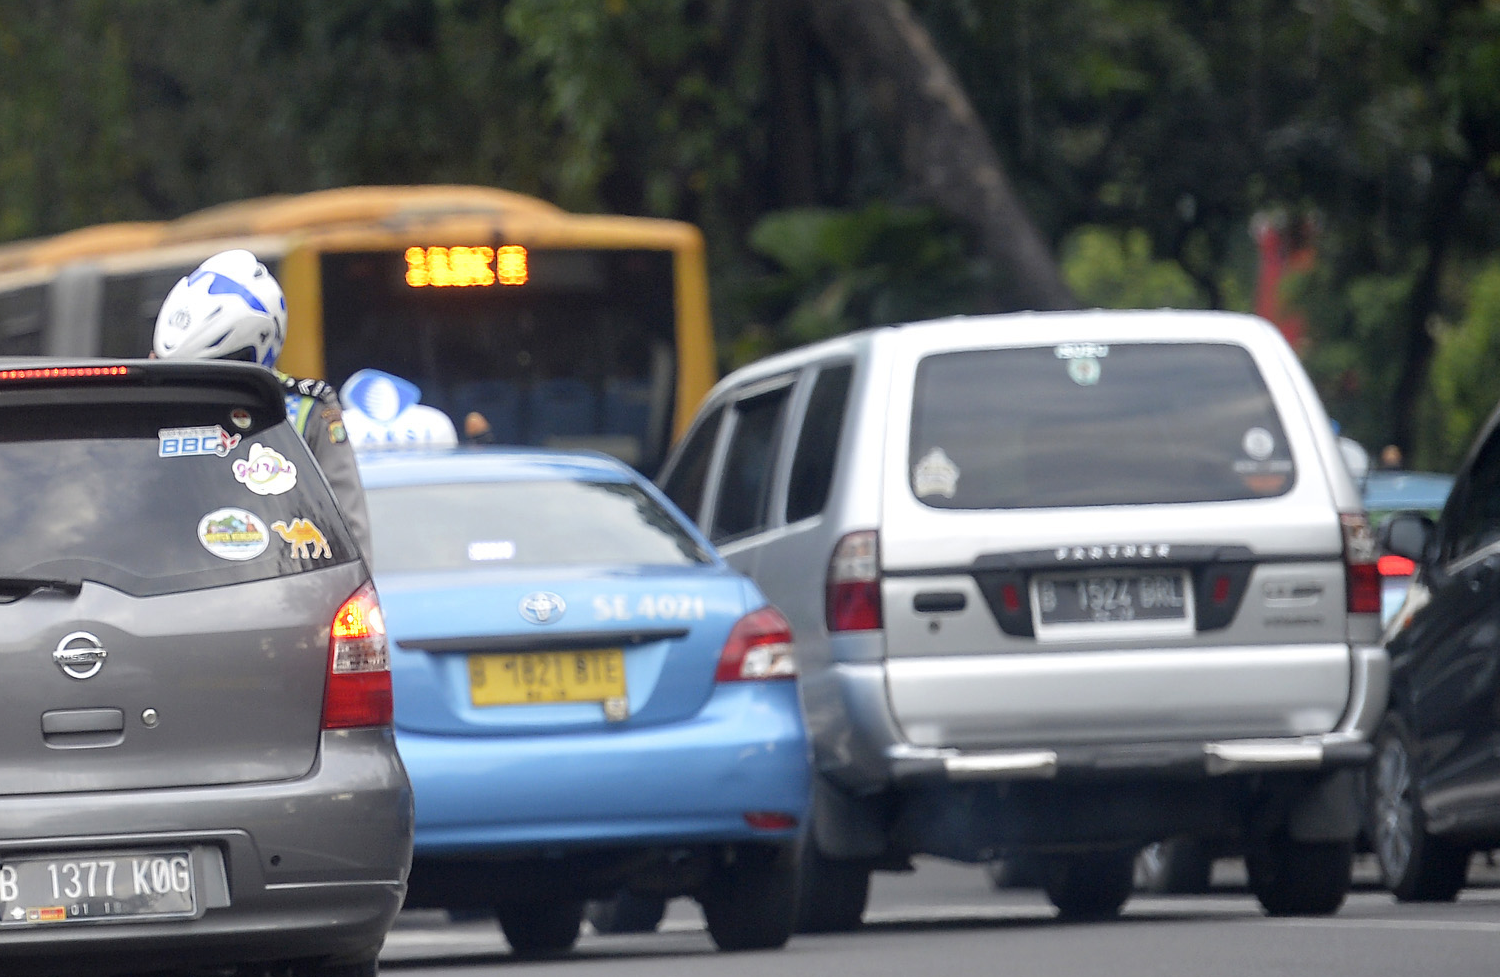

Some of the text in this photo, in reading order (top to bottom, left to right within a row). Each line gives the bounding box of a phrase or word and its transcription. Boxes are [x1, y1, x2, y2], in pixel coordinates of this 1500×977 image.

[162, 436, 218, 455] BBC
[635, 593, 706, 621] 4021
[0, 865, 19, 902] B
[47, 861, 116, 900] 1377
